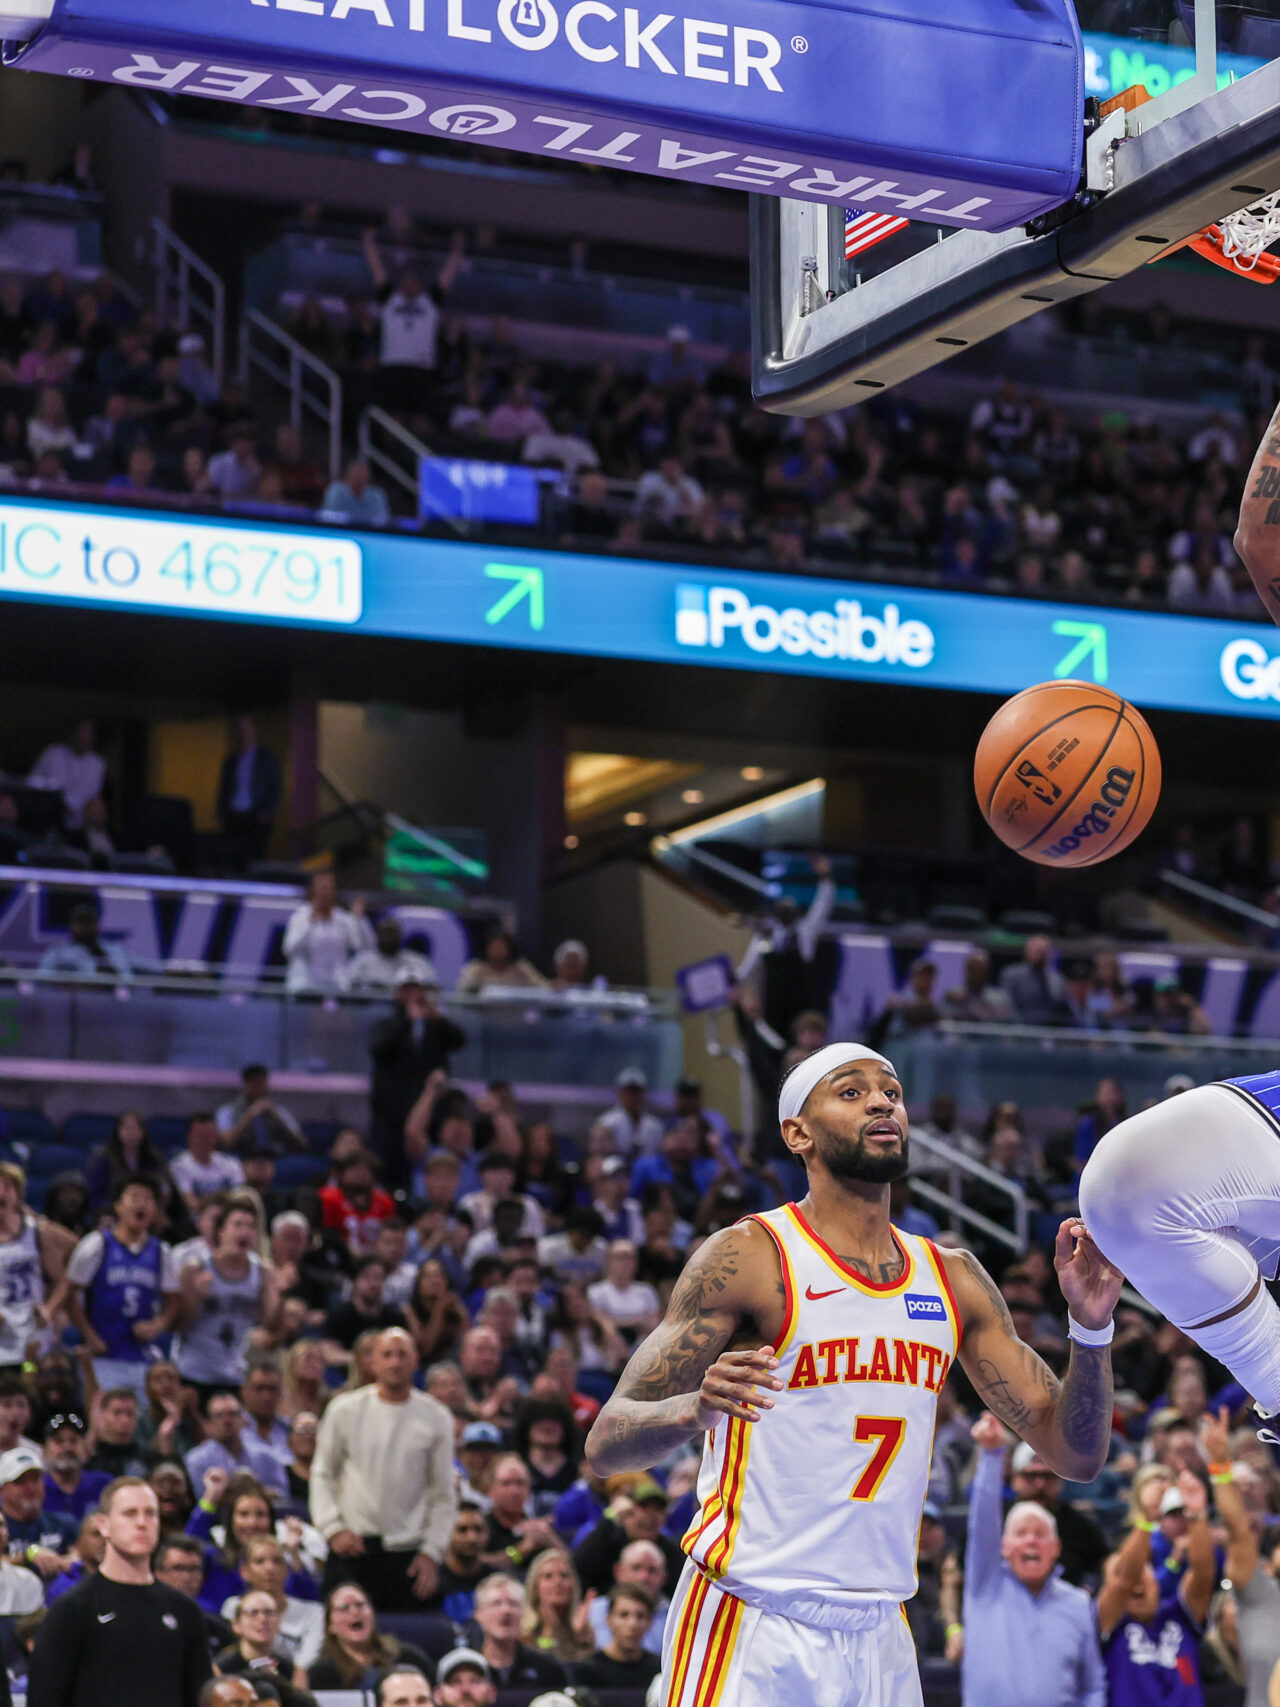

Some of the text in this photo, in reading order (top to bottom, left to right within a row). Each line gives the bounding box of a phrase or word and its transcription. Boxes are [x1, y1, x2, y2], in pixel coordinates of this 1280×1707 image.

[81, 534, 140, 588] to
[158, 538, 346, 606] 46791
[907, 1300, 943, 1314] paze
[849, 1415, 906, 1502] 7
